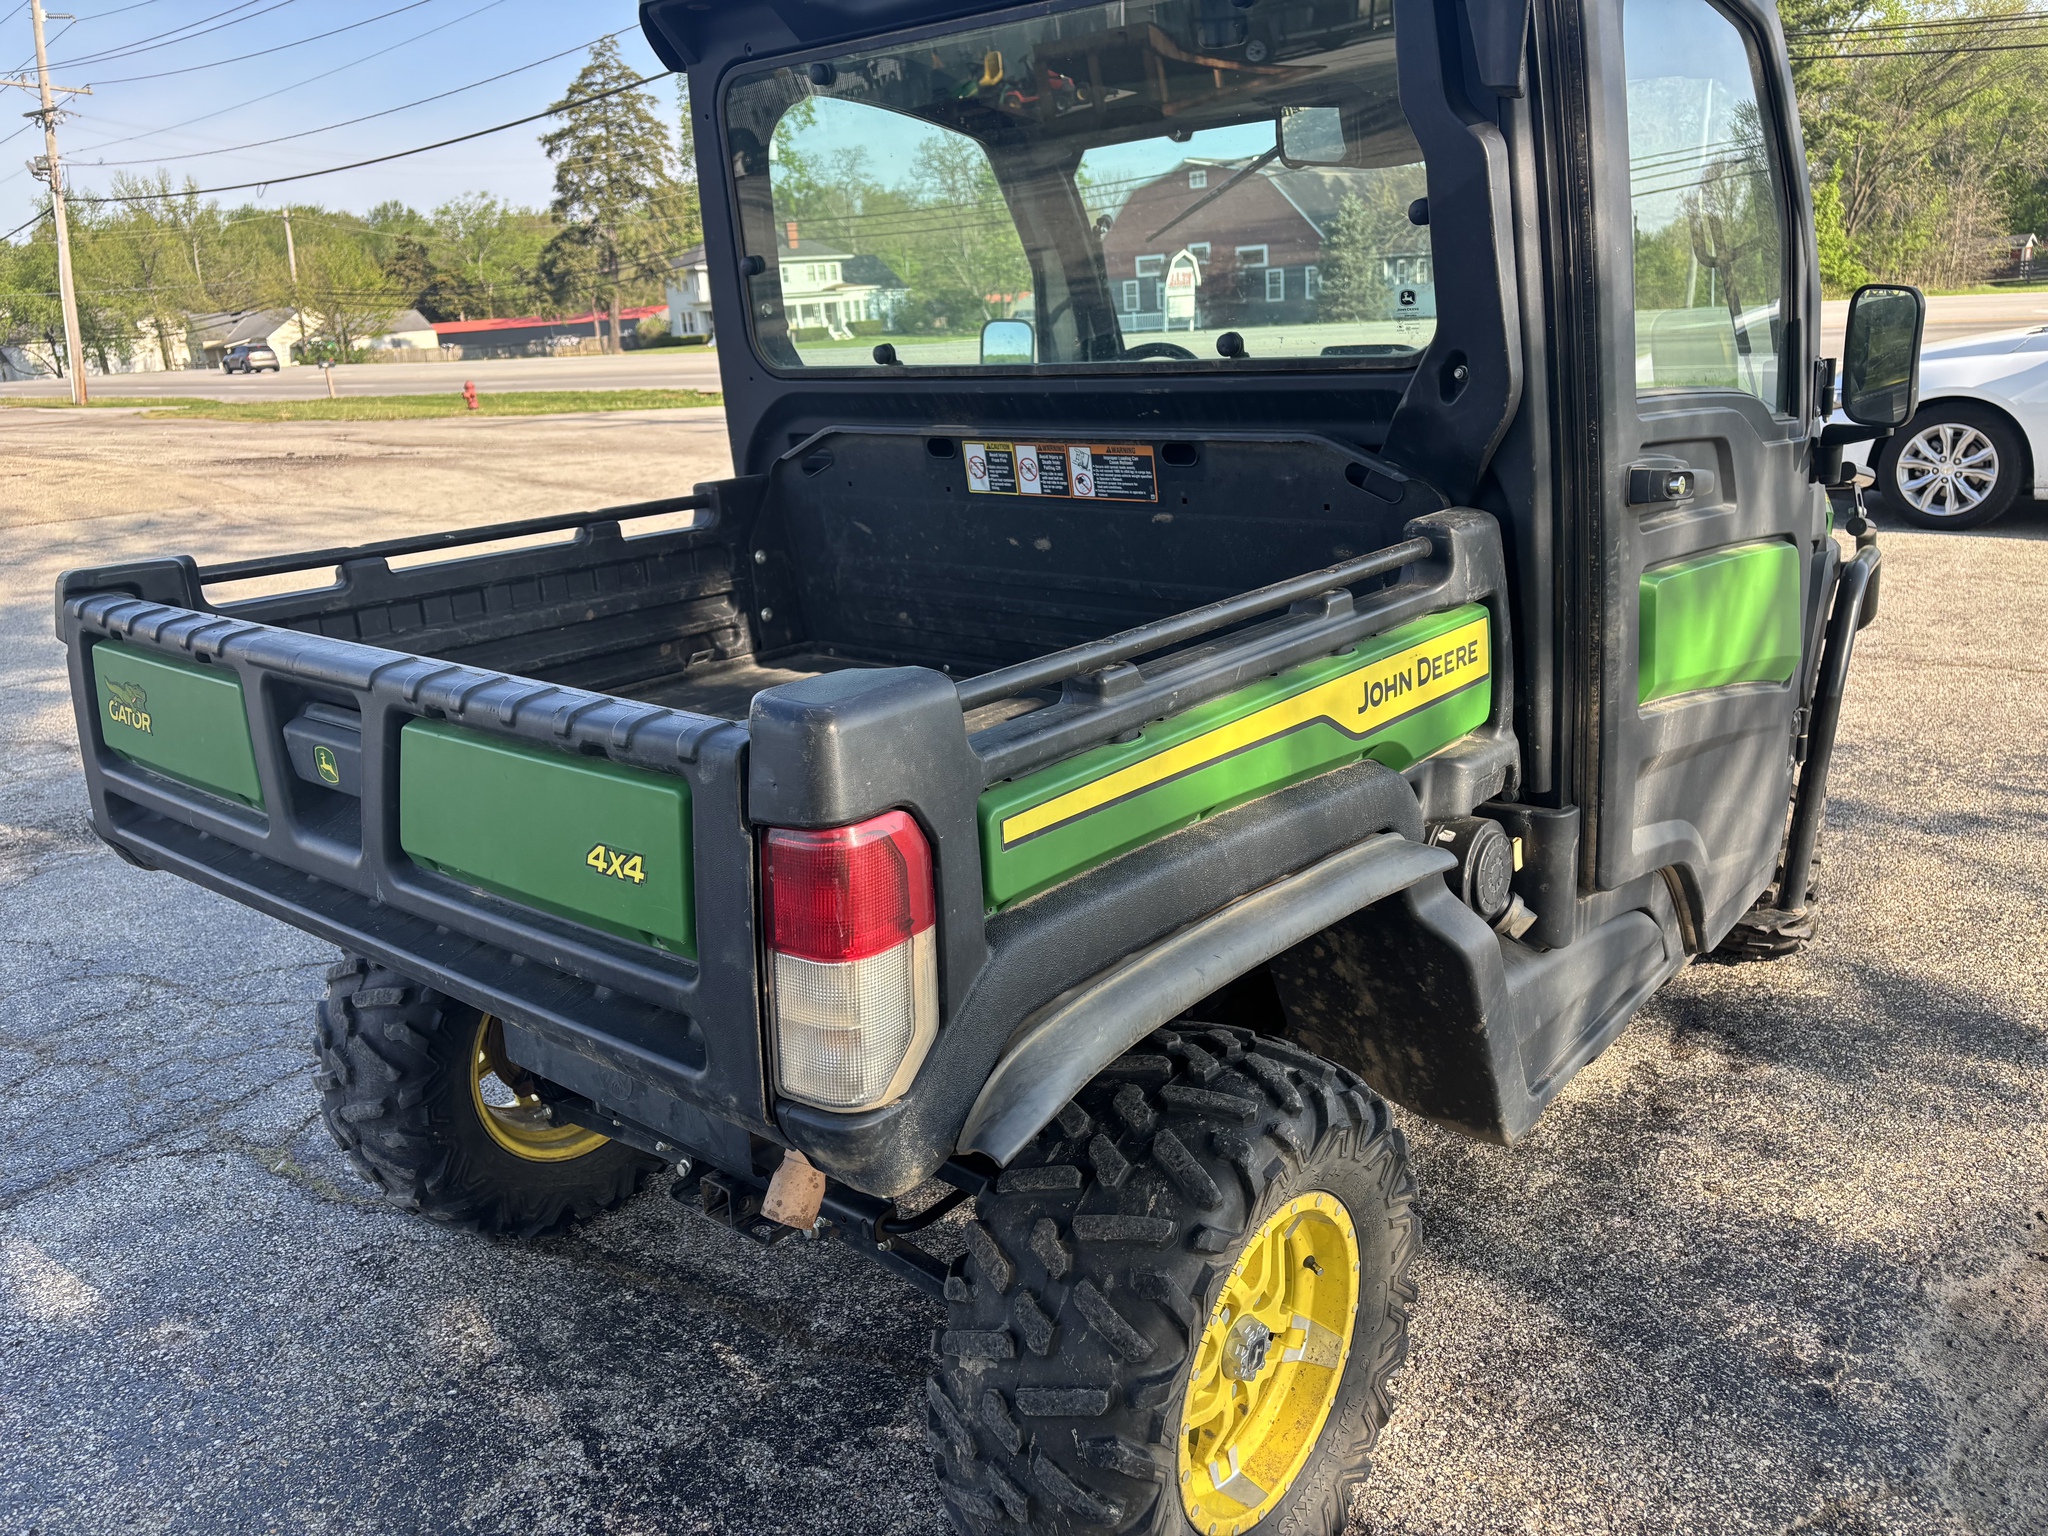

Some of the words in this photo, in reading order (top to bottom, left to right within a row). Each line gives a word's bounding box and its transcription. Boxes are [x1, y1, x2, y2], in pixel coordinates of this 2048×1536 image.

[1111, 446, 1136, 454] WARNING
[1358, 667, 1412, 715] JOHN
[1416, 639, 1478, 688] DEERE
[108, 699, 152, 733] GATOR
